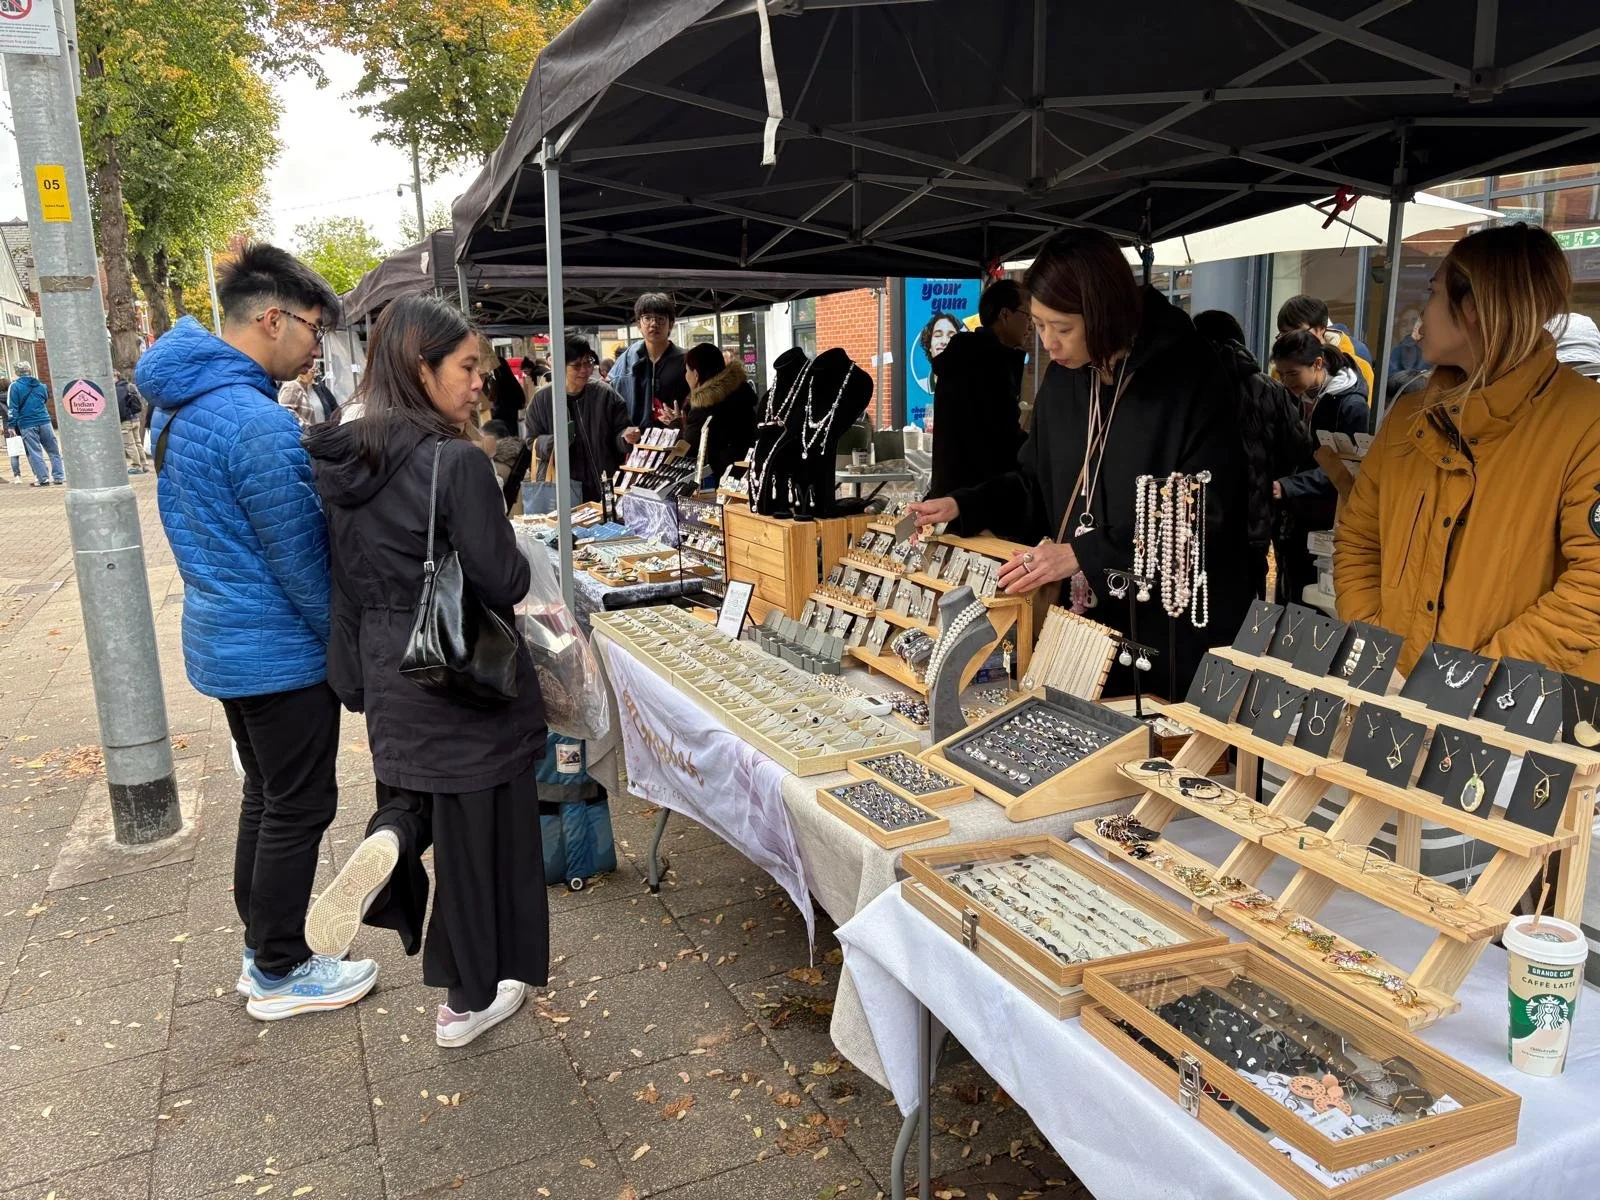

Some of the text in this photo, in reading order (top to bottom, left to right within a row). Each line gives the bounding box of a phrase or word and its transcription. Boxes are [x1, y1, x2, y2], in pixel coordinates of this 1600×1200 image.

[43, 179, 60, 190] 05
[922, 283, 962, 301] your
[931, 297, 968, 316] gum
[1532, 967, 1572, 978] GRANDE CUP
